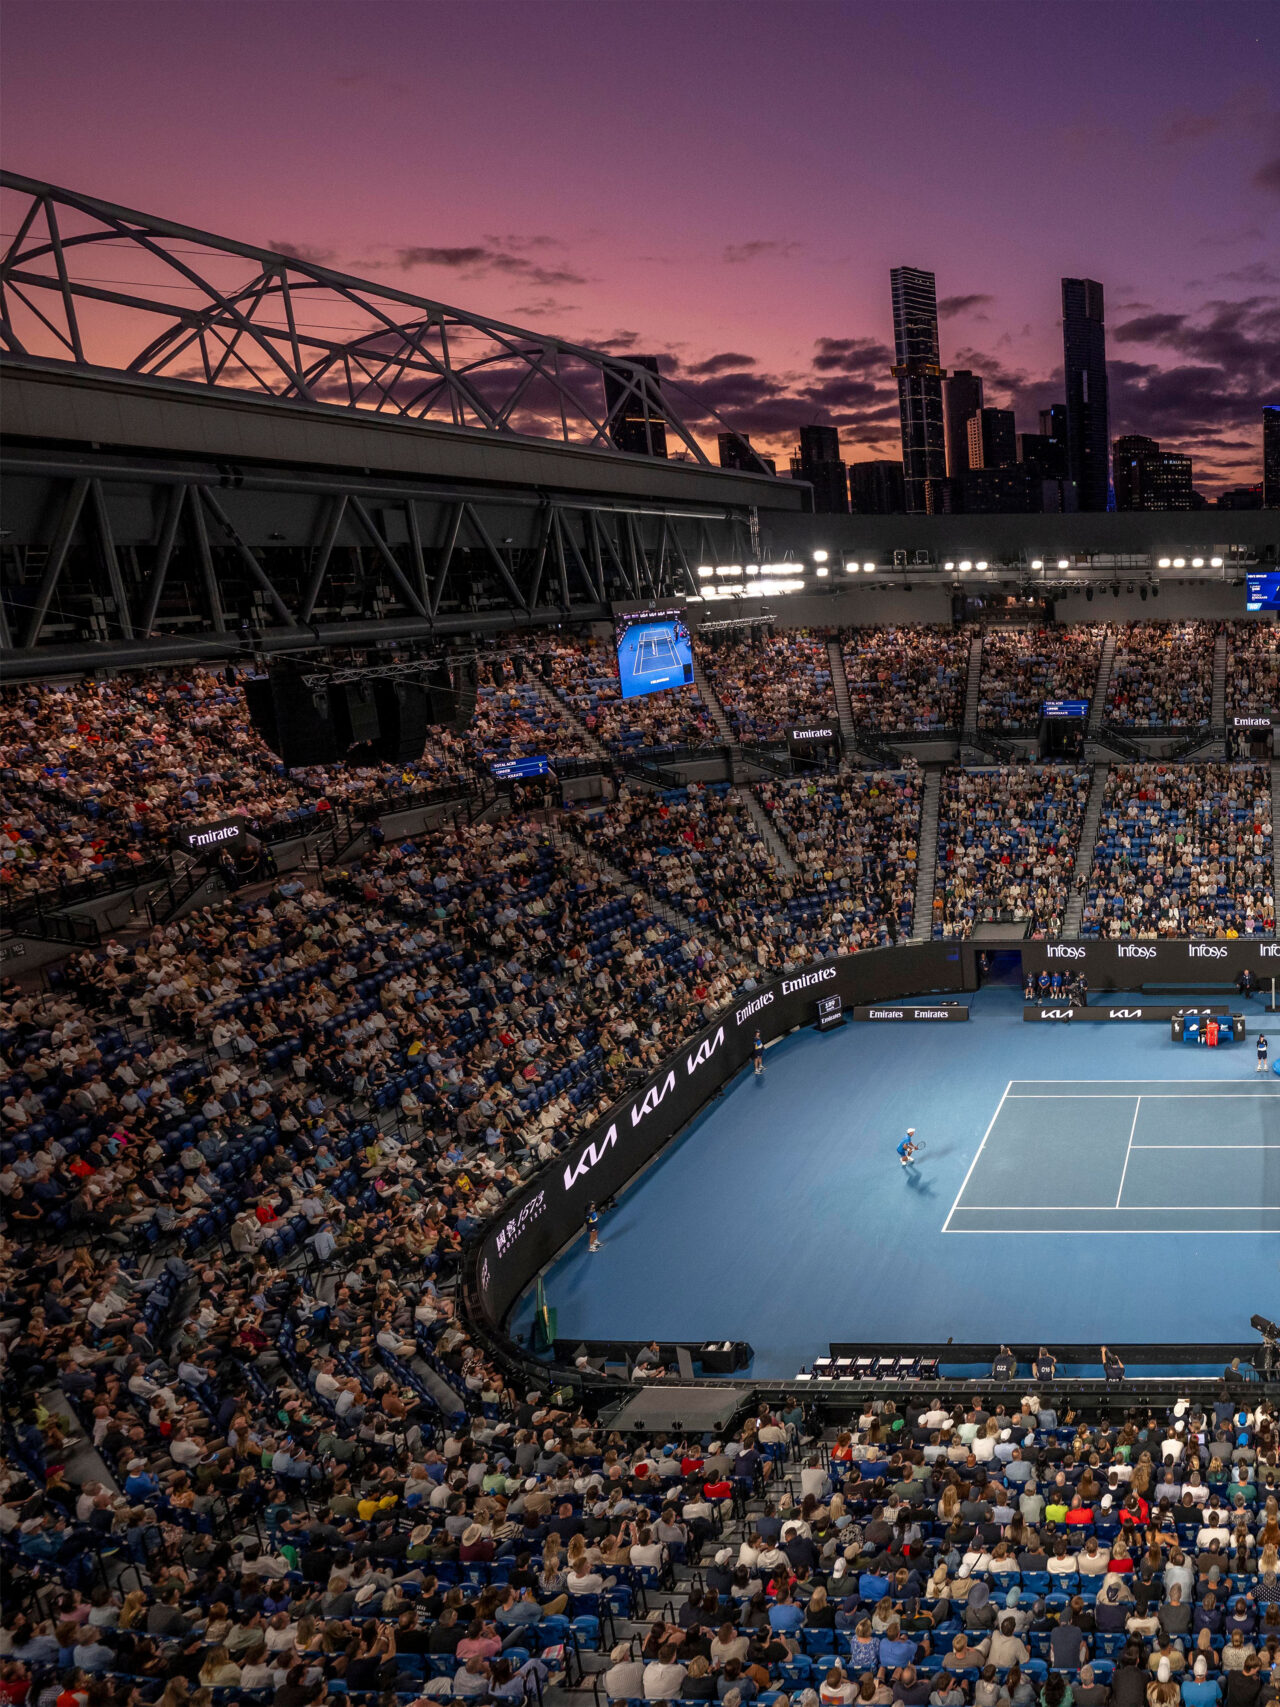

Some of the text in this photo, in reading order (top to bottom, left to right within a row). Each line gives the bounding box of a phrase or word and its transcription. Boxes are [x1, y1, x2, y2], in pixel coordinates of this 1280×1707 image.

[1234, 717, 1271, 726] Emirates
[793, 728, 832, 740] Emirates
[188, 825, 239, 848] Emirates
[1046, 944, 1086, 960] Infosys
[1117, 944, 1157, 960] Infosys
[1188, 944, 1228, 959] Infosys
[781, 965, 837, 996] Emirates
[735, 990, 775, 1026] Emirates
[869, 1010, 904, 1019] Emirates
[914, 1010, 949, 1019] Emirates
[1040, 1009, 1074, 1019] KIA
[1109, 1009, 1142, 1018] KIA
[686, 1026, 725, 1075] KIA
[629, 1070, 676, 1127] KIA
[563, 1123, 617, 1191] KIA
